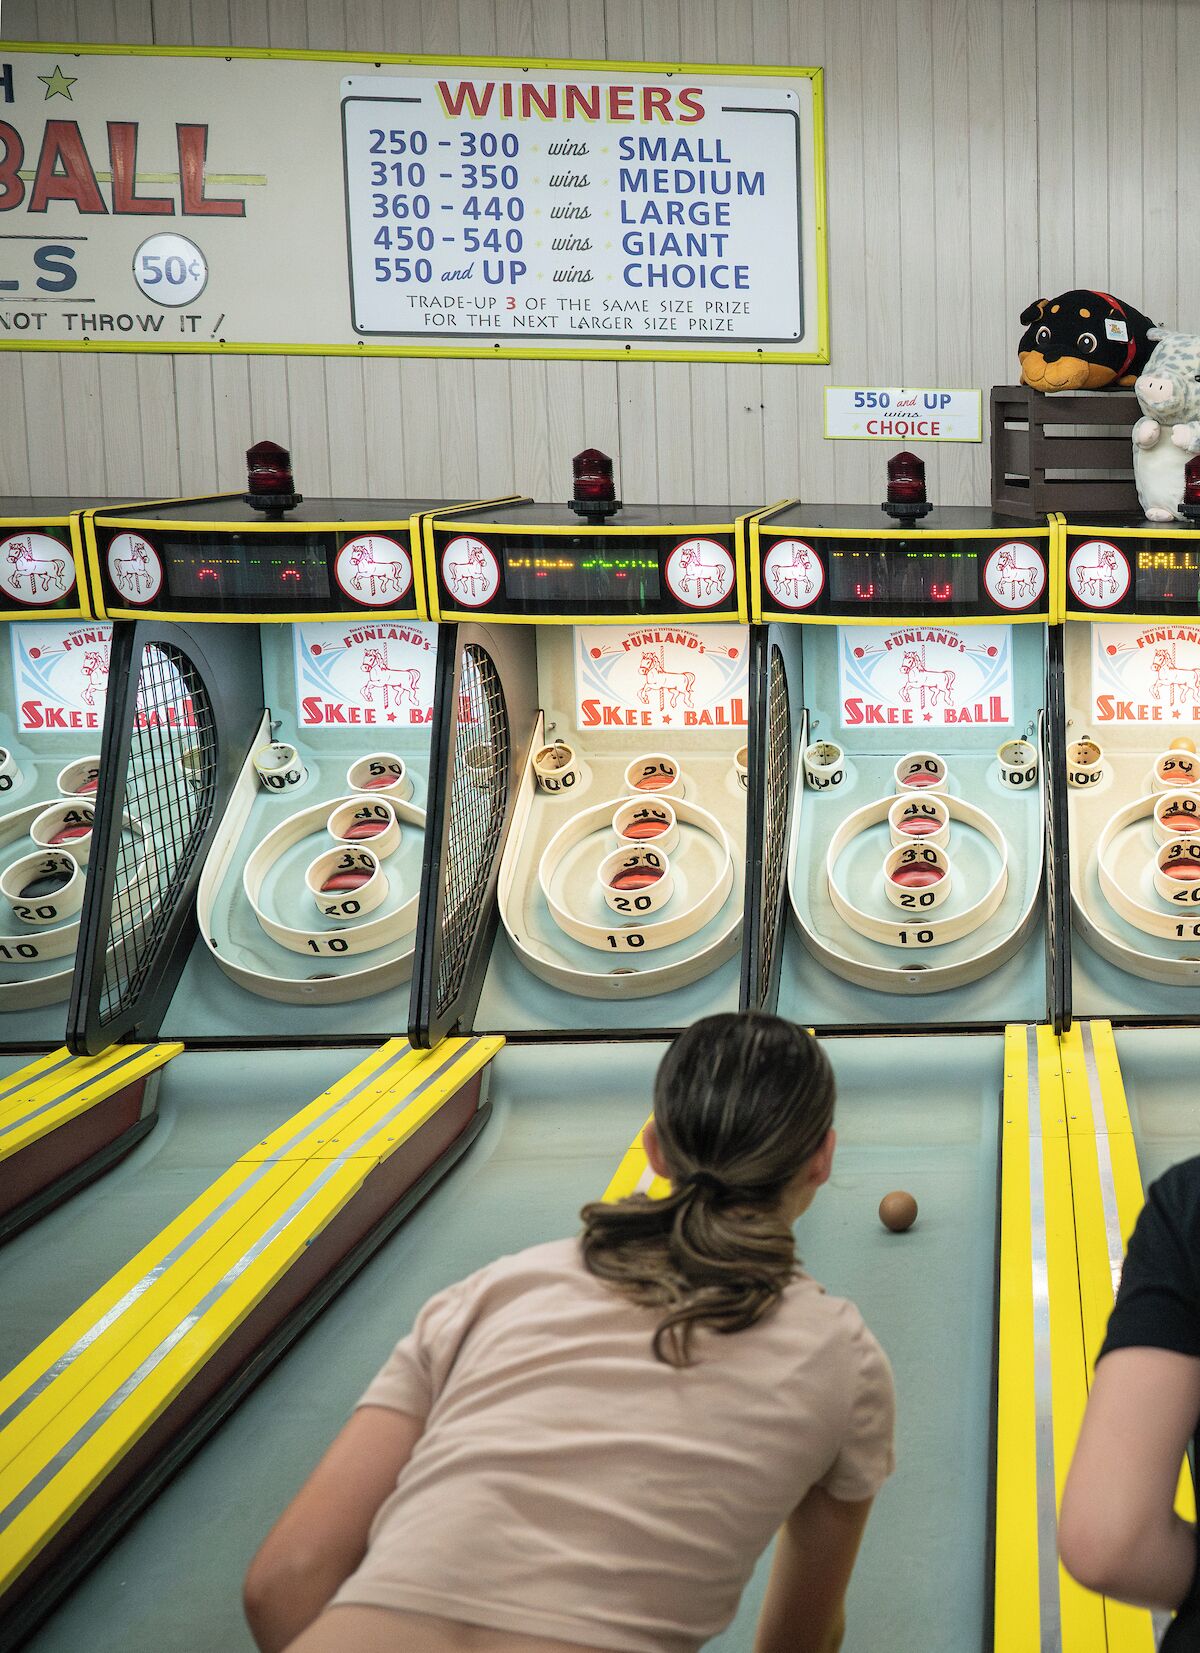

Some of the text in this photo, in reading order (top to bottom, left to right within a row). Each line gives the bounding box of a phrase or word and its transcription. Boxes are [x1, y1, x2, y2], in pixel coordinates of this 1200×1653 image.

[435, 80, 706, 123] WINNERS
[547, 138, 590, 157] wins
[618, 135, 731, 163] SMALL
[548, 170, 591, 188] wins
[619, 168, 765, 196] MEDIUM
[550, 202, 592, 220] wins
[621, 200, 731, 226] LARGE
[551, 234, 593, 252] wins
[622, 232, 729, 258] GIANT
[141, 255, 201, 286] 50¢
[374, 257, 750, 290] 550 and UP wins CHOICE
[407, 295, 751, 315] TRADE-UP 3 OF THE SAME SIZE PRIZE
[62, 313, 164, 333] THROW
[424, 312, 735, 332] FOR THE NEXT LARGER SIZE PRIZE
[854, 391, 951, 409] 550 and UP
[883, 410, 922, 418] wins
[866, 420, 940, 436] CHOICE
[1138, 552, 1198, 570] BALL
[21, 700, 99, 729] SKEE
[302, 696, 377, 724] SKEE
[581, 698, 748, 726] SKEE BALL
[844, 696, 1009, 724] SKEE BALL
[1097, 694, 1162, 721] SKEE
[370, 762, 402, 775] 50
[1001, 766, 1036, 784] 100
[1069, 770, 1102, 784] 100
[902, 849, 937, 863] 30
[614, 896, 651, 912] 20
[900, 892, 935, 908] 20
[13, 905, 57, 920] 20
[308, 938, 349, 953] 10
[607, 934, 644, 948] 10
[899, 930, 934, 943] 10
[0, 944, 39, 959] 10
